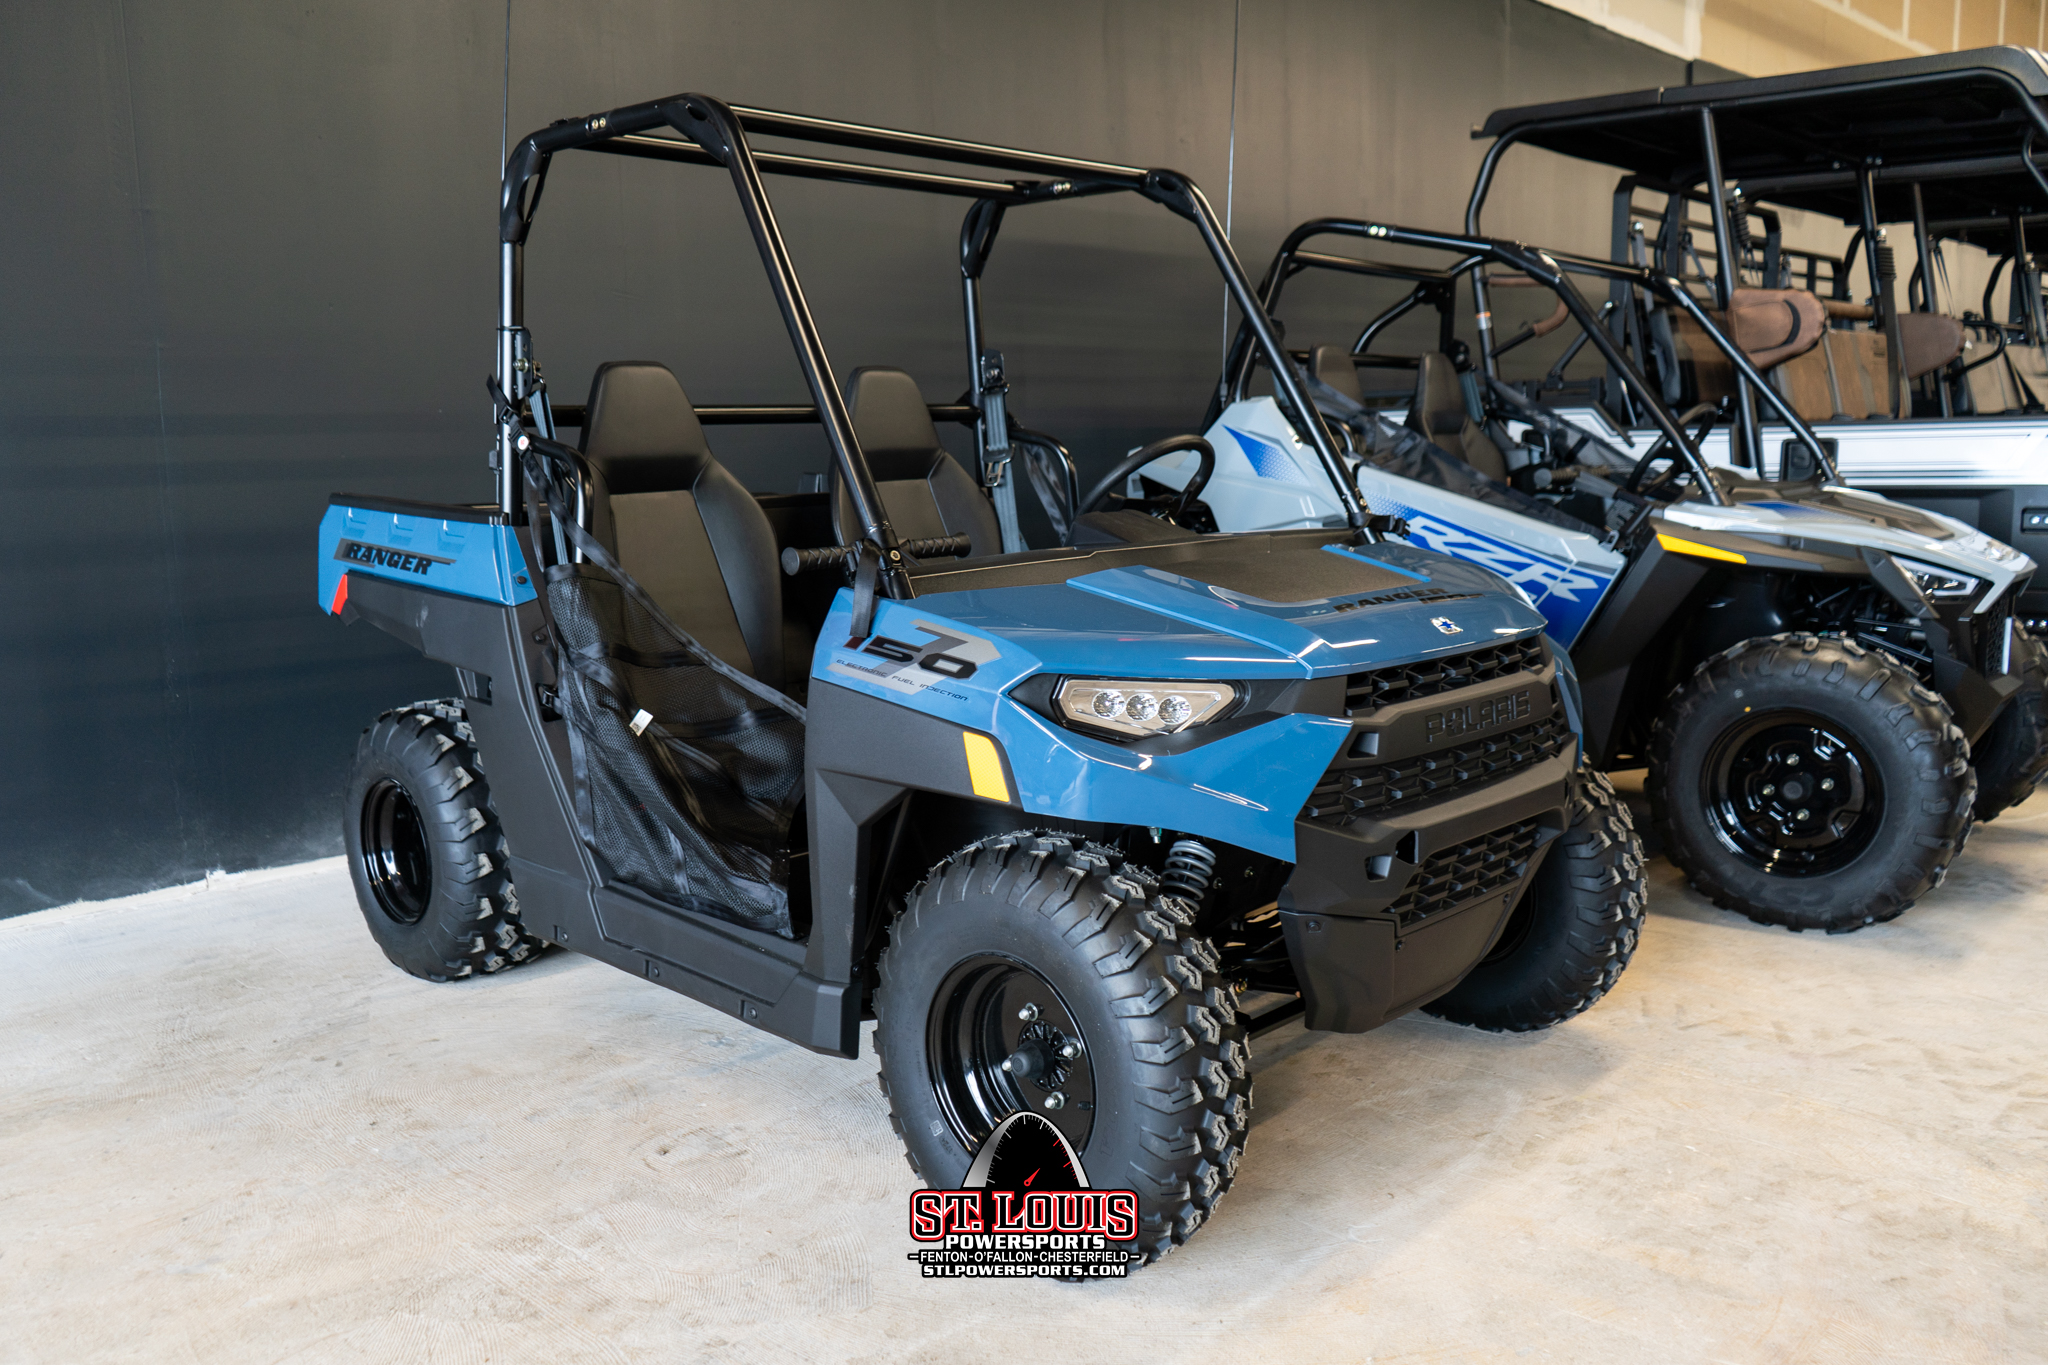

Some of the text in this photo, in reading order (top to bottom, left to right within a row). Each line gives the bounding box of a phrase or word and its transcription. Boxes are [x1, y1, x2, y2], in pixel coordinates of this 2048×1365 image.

[346, 543, 432, 575] RANGER
[1407, 515, 1599, 602] RZR
[1333, 587, 1449, 613] RANGER
[836, 658, 968, 702] ELECTRONIC FUEL INJECTION
[1425, 690, 1531, 743] POLARIS
